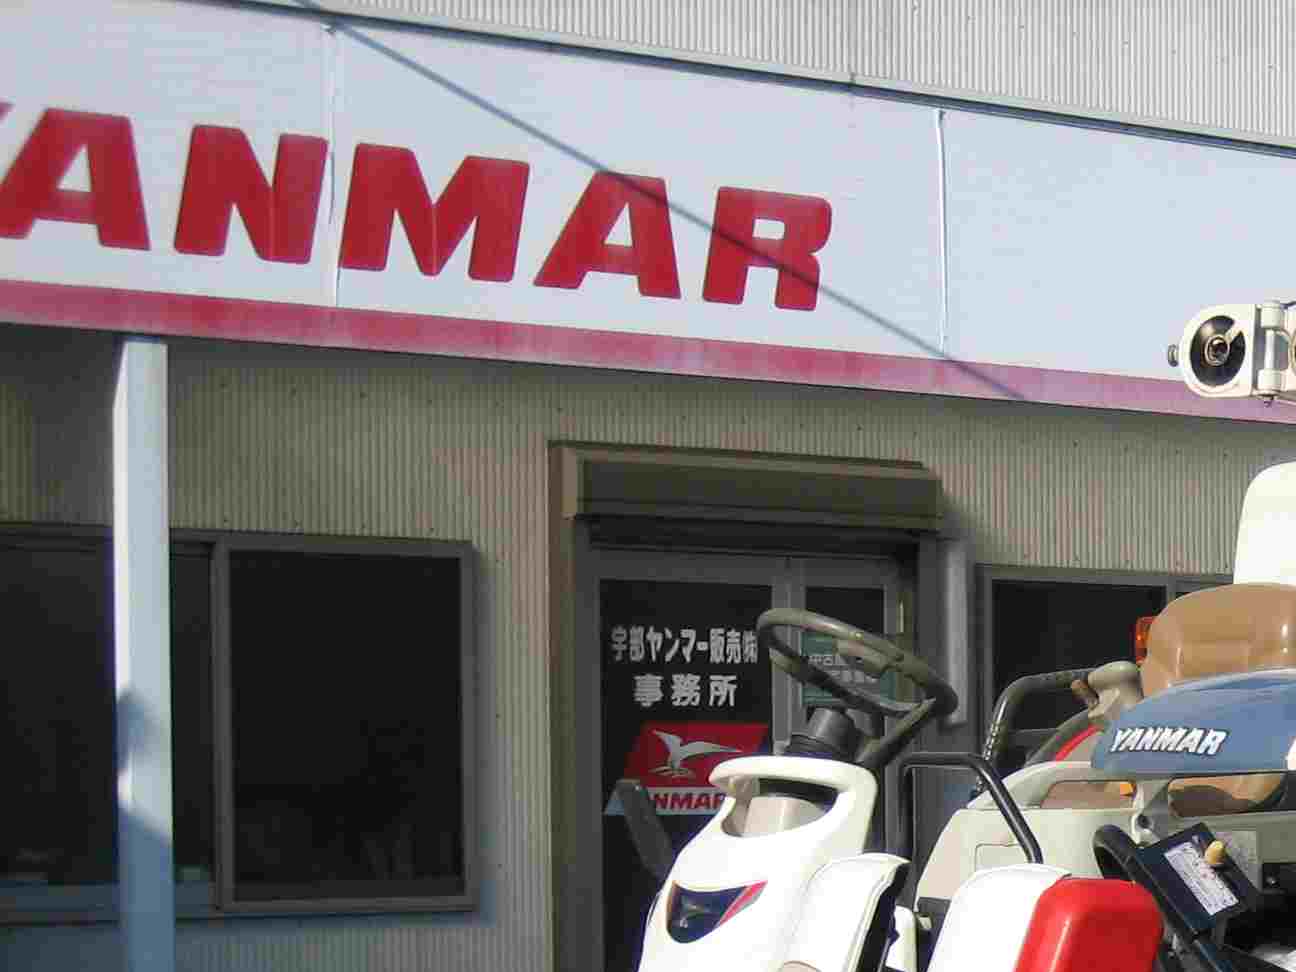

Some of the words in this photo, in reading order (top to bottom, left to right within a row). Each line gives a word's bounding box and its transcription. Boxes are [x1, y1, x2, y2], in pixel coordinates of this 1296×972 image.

[0, 103, 833, 312] ANMAR
[633, 673, 738, 707] 事務所
[1109, 727, 1229, 756] YANMAR
